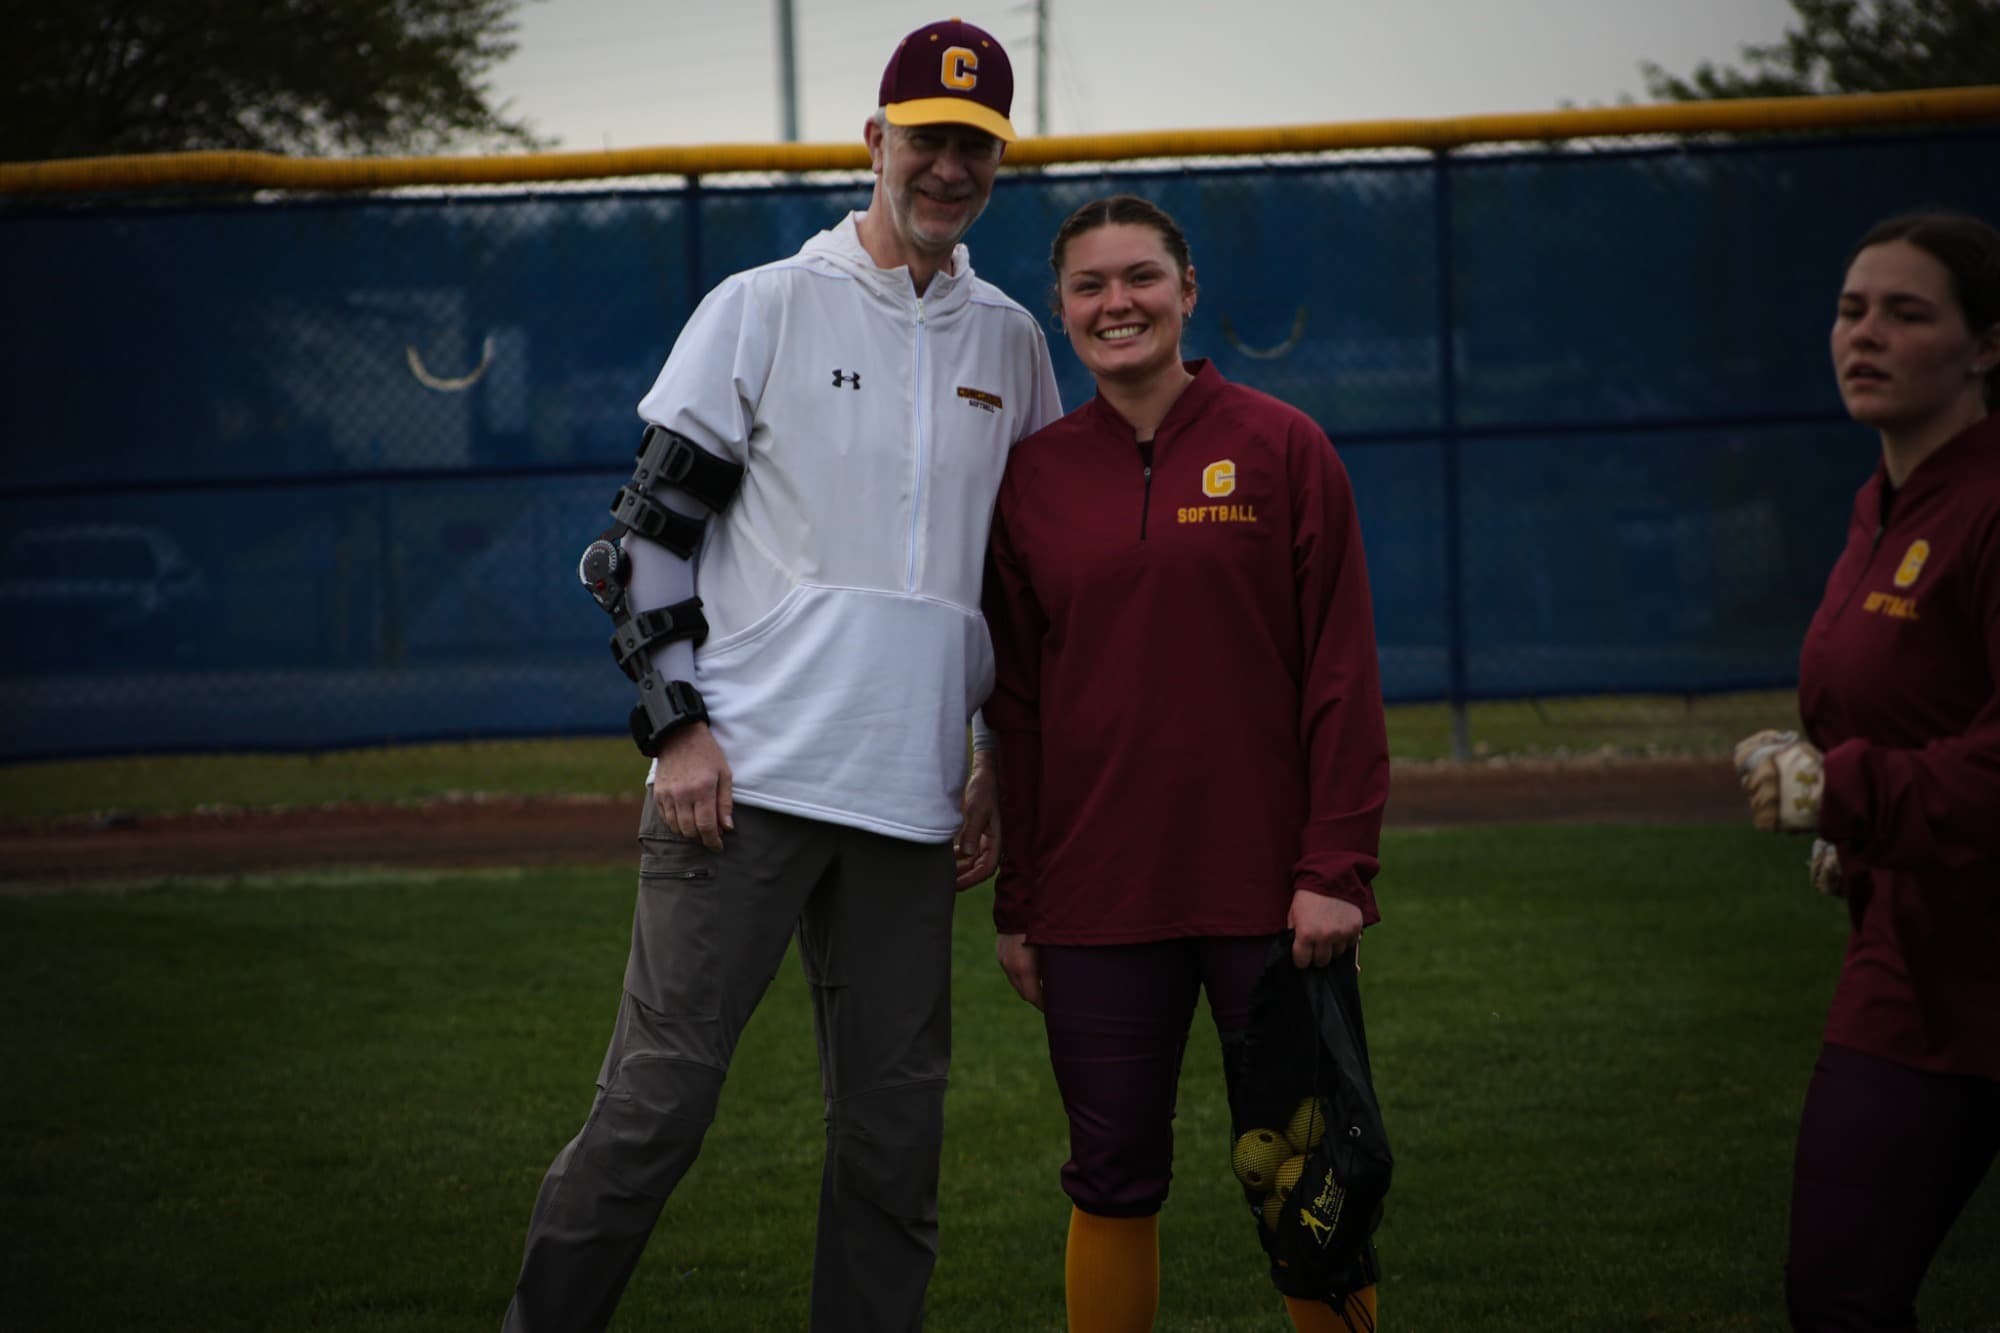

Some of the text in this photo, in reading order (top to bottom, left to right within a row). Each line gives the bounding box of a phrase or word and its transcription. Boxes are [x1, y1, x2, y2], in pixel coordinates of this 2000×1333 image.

[941, 46, 978, 91] C
[1202, 458, 1236, 498] C
[1177, 504, 1257, 524] SOFTBALL
[1894, 539, 1930, 589] C
